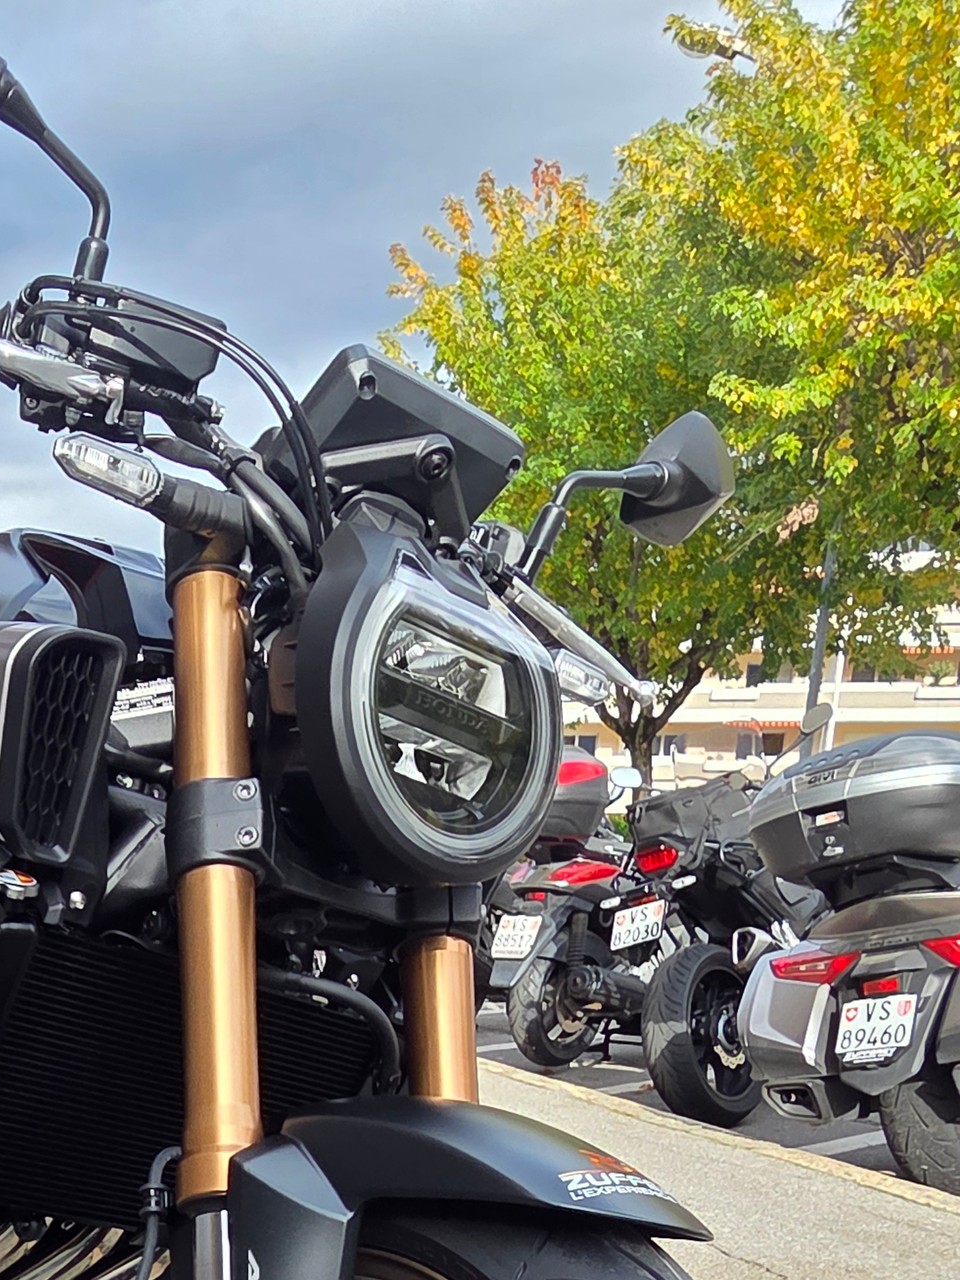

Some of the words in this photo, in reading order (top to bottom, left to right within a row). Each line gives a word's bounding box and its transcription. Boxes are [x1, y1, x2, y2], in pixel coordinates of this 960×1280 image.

[630, 906, 649, 925] VS
[613, 921, 660, 946] 82030
[866, 1000, 891, 1022] VS
[840, 1023, 906, 1050] 89460
